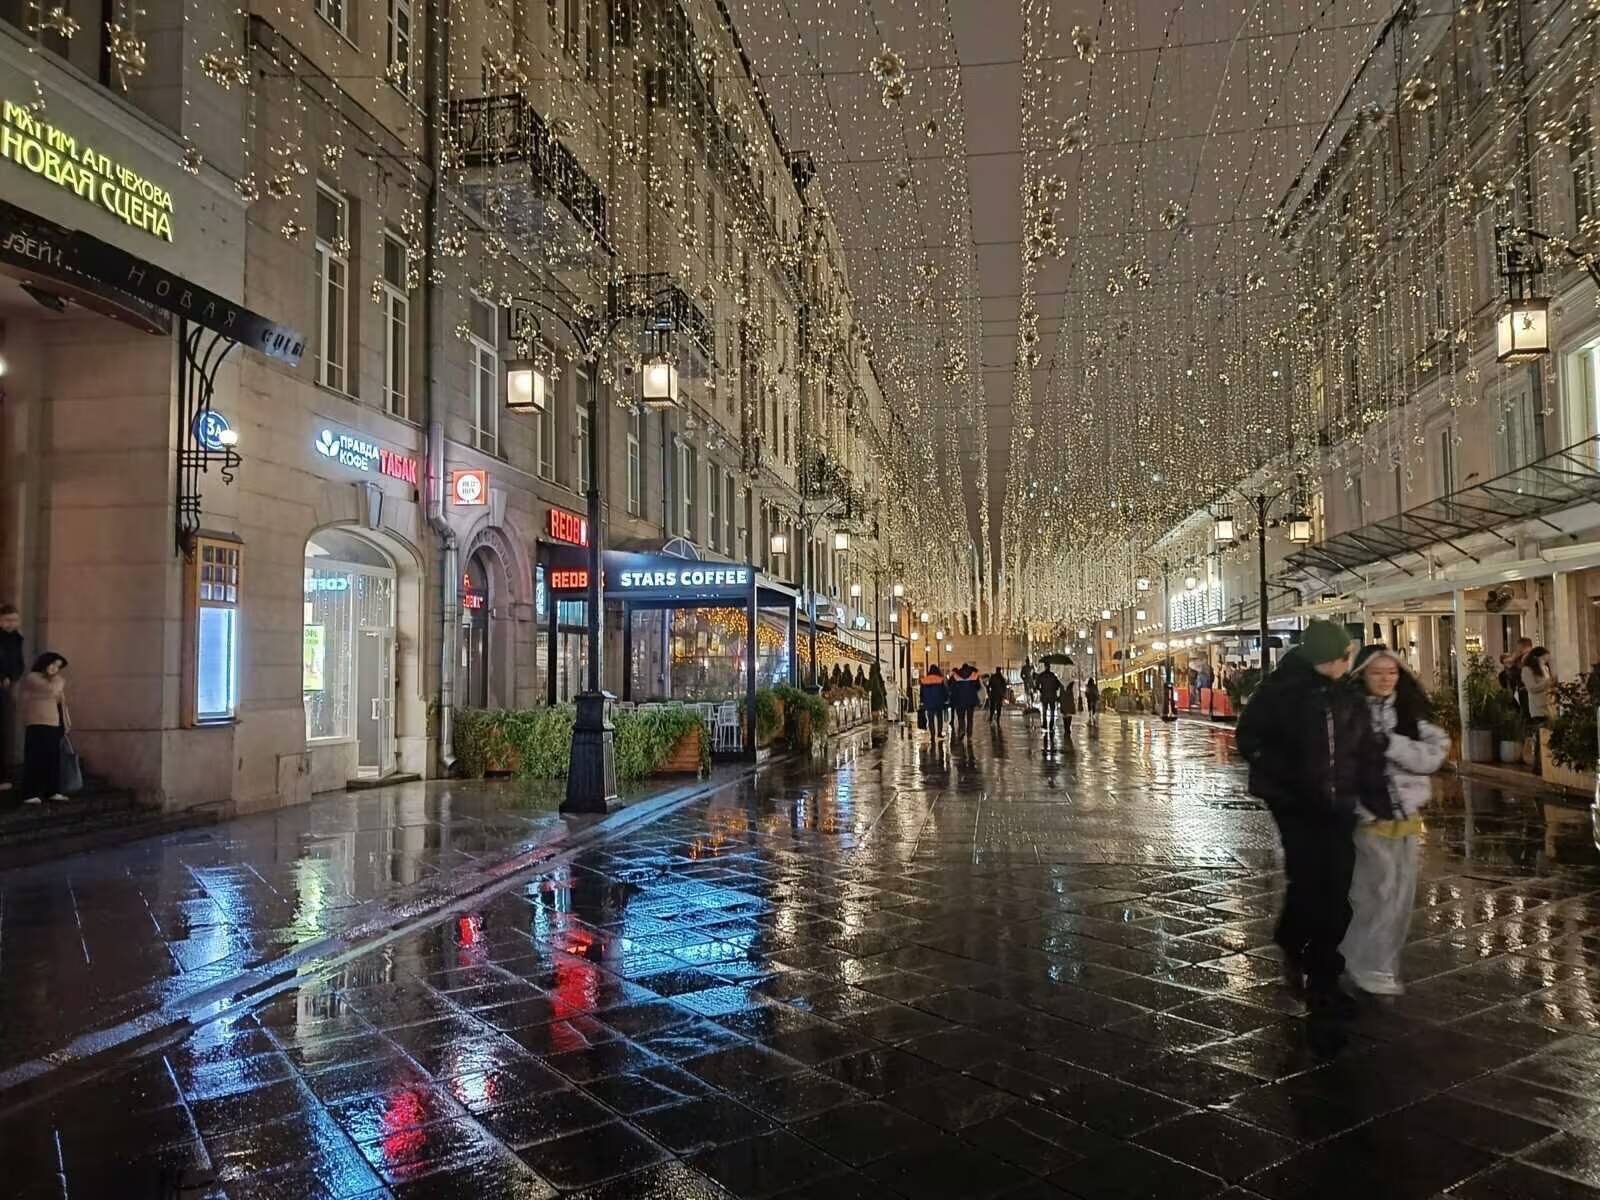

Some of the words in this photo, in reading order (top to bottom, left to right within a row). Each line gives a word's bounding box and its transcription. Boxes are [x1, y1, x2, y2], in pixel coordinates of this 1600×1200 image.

[2, 125, 95, 202] НОВАЯ
[102, 182, 174, 243] СЦЕНА
[116, 164, 174, 213] ЧЕХОВА
[127, 265, 237, 328] НОВАЯ
[340, 435, 379, 460] ПРАВДА
[340, 448, 368, 471] КОФЕ
[380, 449, 417, 484] ТАБАК
[621, 571, 676, 587] STARS
[681, 570, 747, 585] COFFEE
